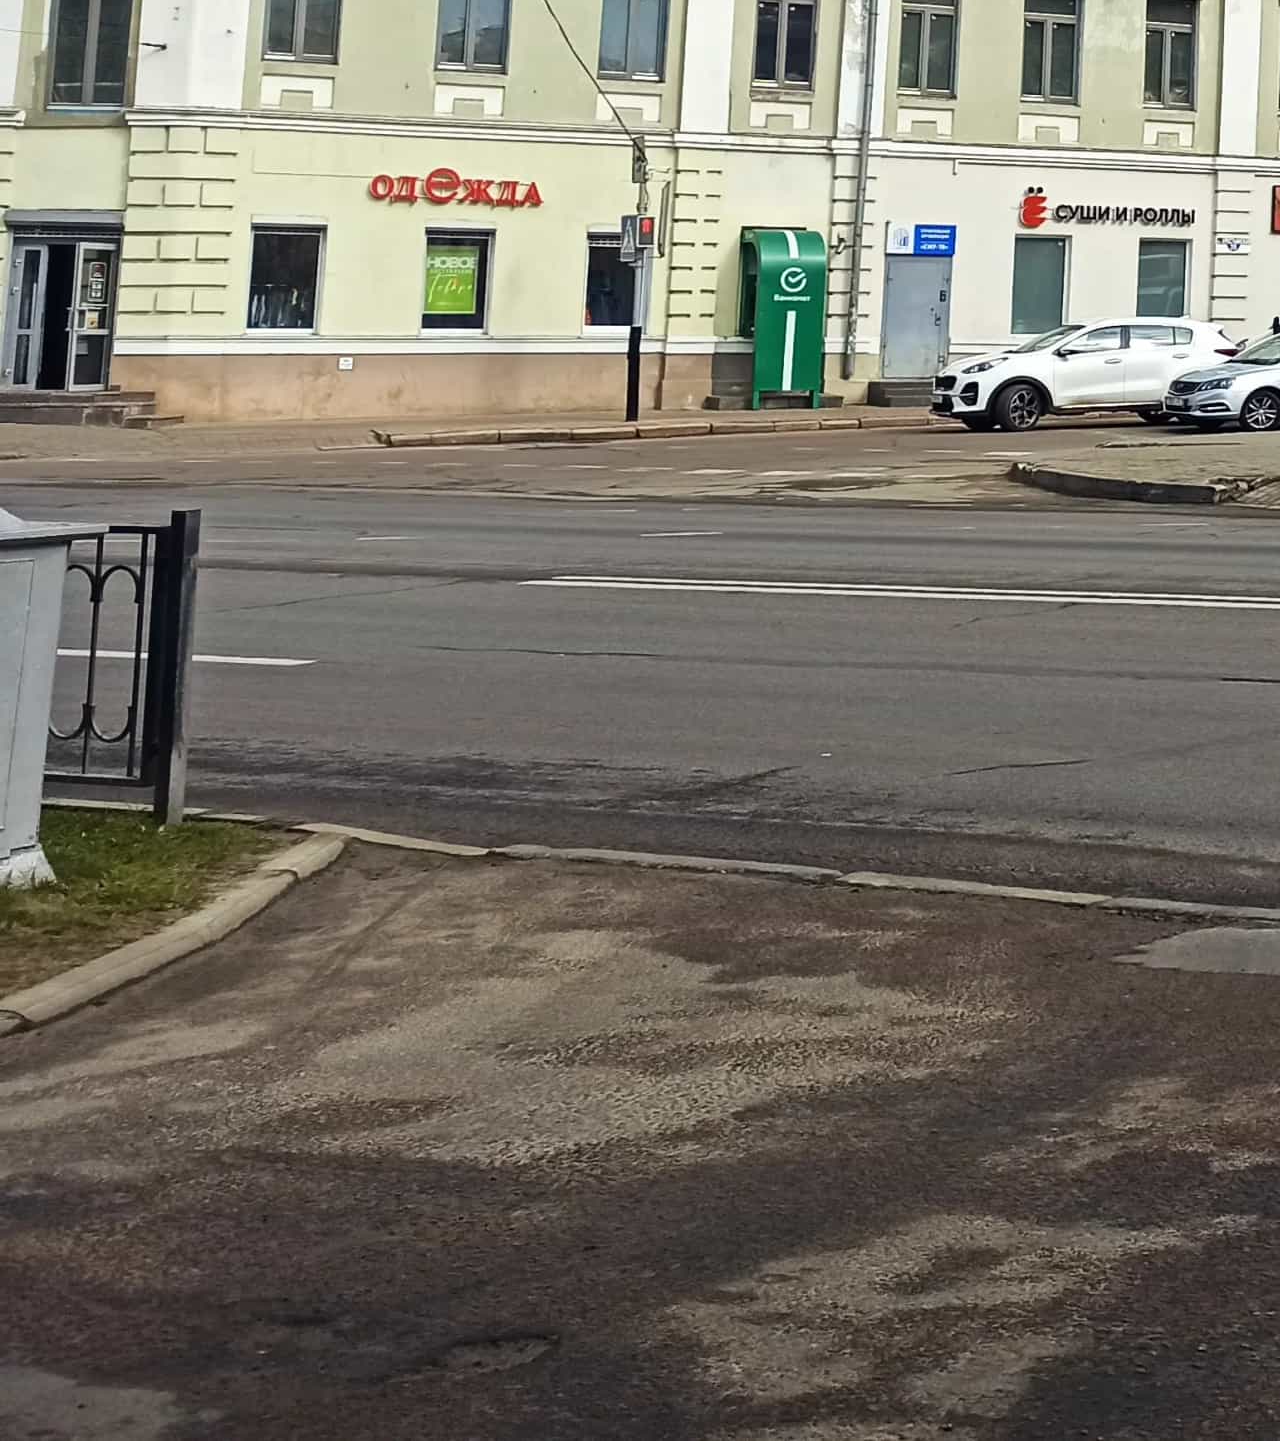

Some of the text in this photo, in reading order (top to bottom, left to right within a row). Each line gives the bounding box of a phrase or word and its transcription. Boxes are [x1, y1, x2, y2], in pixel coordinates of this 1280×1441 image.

[369, 168, 544, 207] ОДЕЖДА
[1054, 204, 1196, 225] СУШИ И РОЛЛЫ
[426, 256, 478, 269] НОВОЕ
